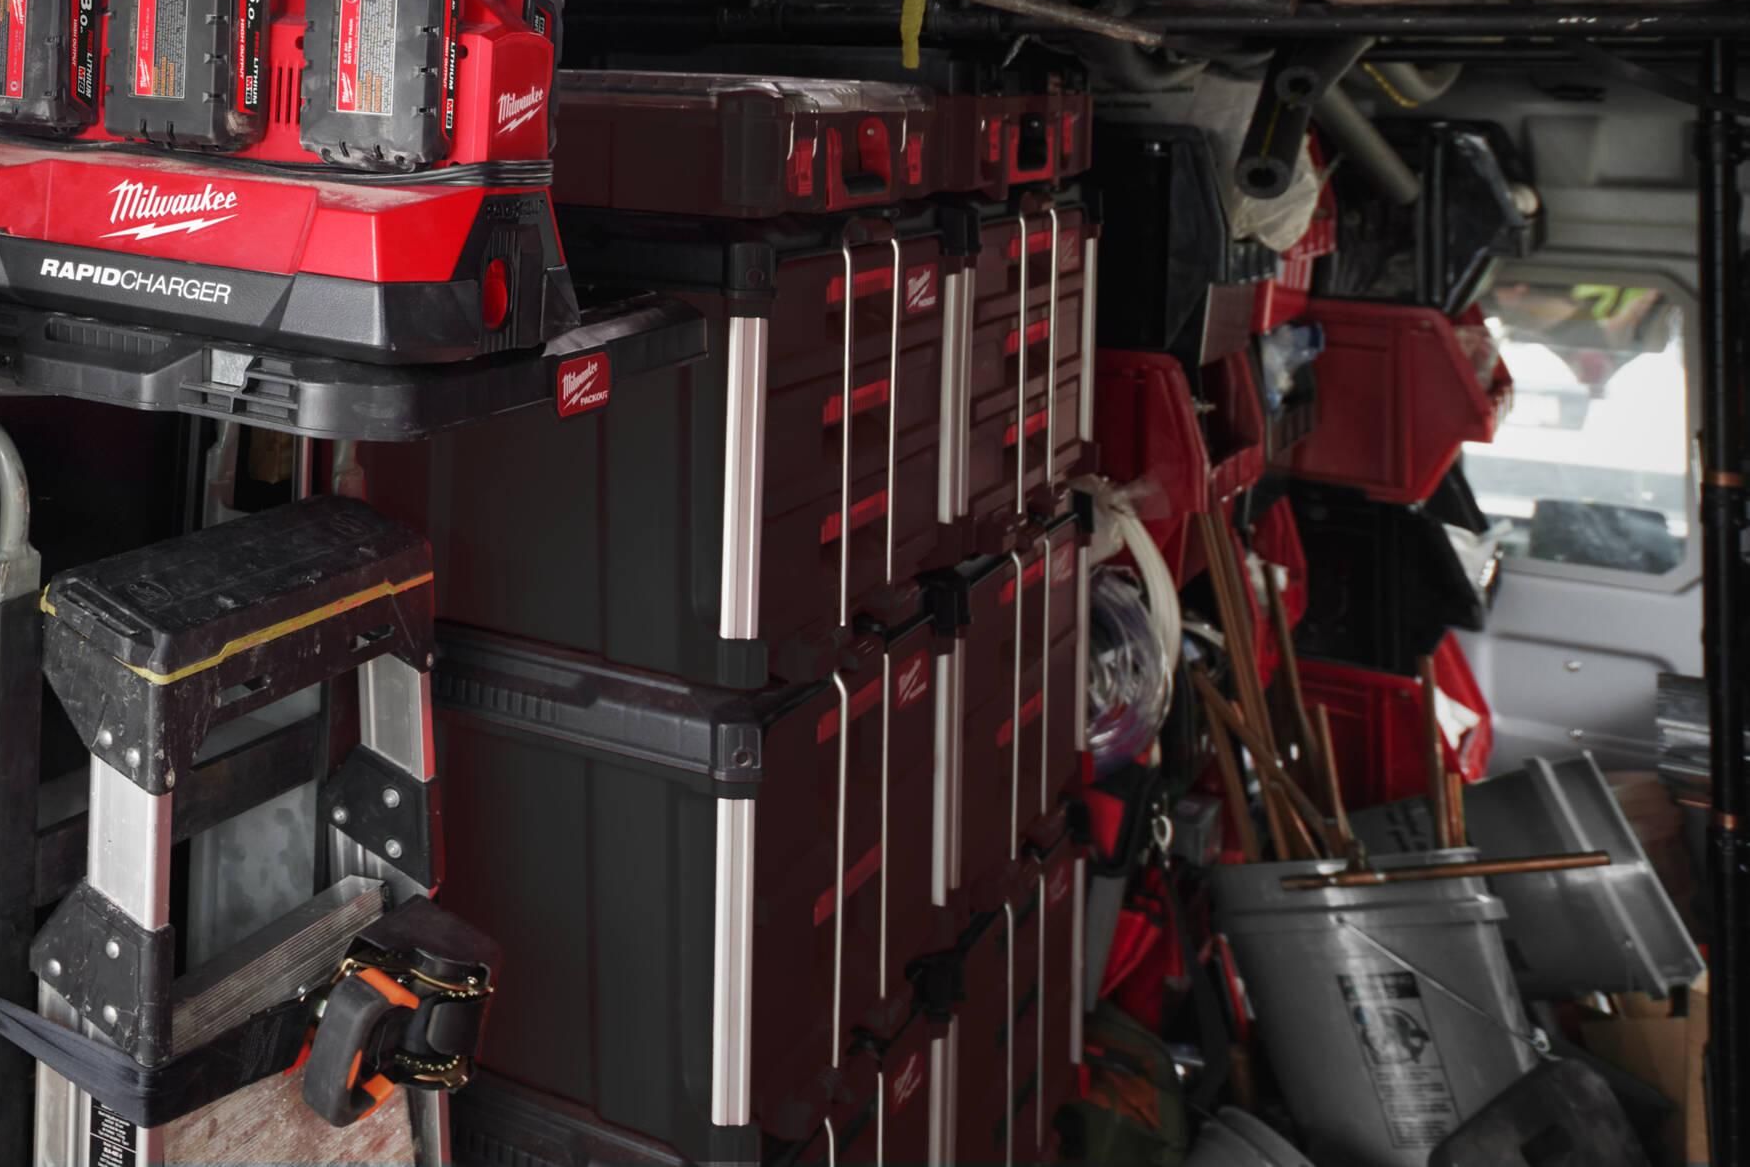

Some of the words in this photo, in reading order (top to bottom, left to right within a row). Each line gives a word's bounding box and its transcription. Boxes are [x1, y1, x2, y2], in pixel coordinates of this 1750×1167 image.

[78, 65, 86, 94] M18
[497, 85, 544, 124] Milwaukee
[108, 179, 239, 224] Milwaukee
[40, 258, 231, 305] RAPIDCHARGER
